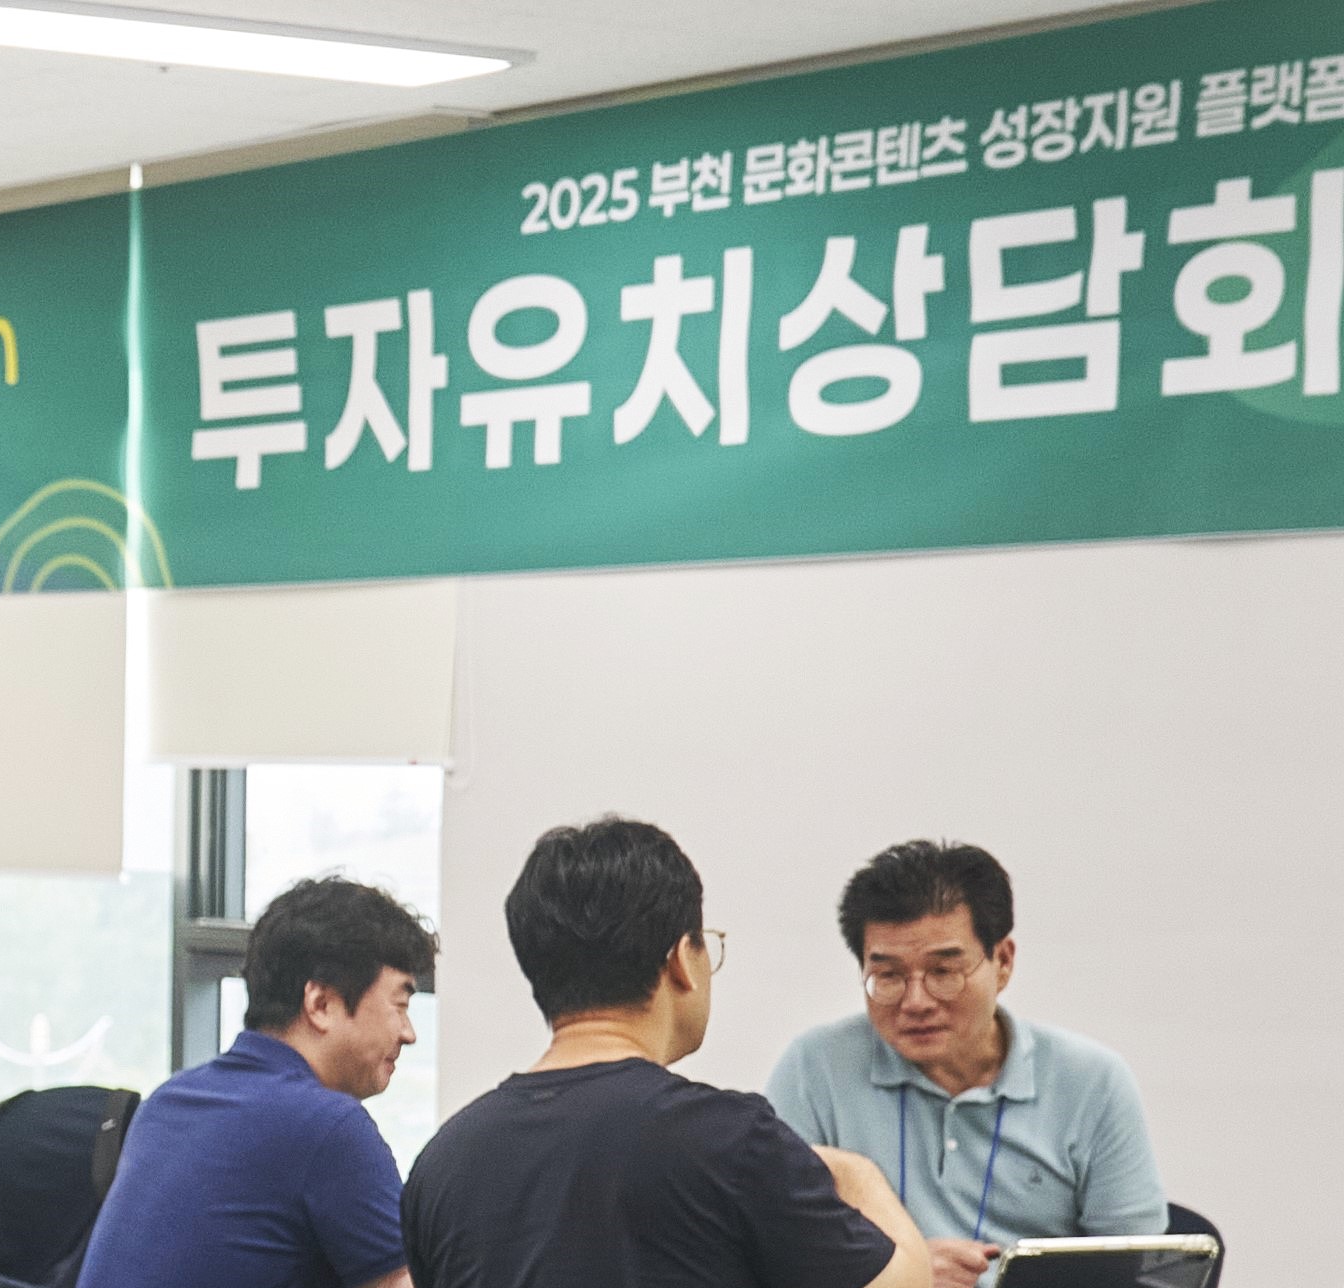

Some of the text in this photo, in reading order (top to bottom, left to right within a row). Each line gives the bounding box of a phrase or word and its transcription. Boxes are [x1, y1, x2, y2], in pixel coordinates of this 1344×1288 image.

[520, 54, 1344, 235] 2025 부천 문화콘텐츠 성장지원 플랫폼
[192, 166, 1344, 489] 투자유치상담회
